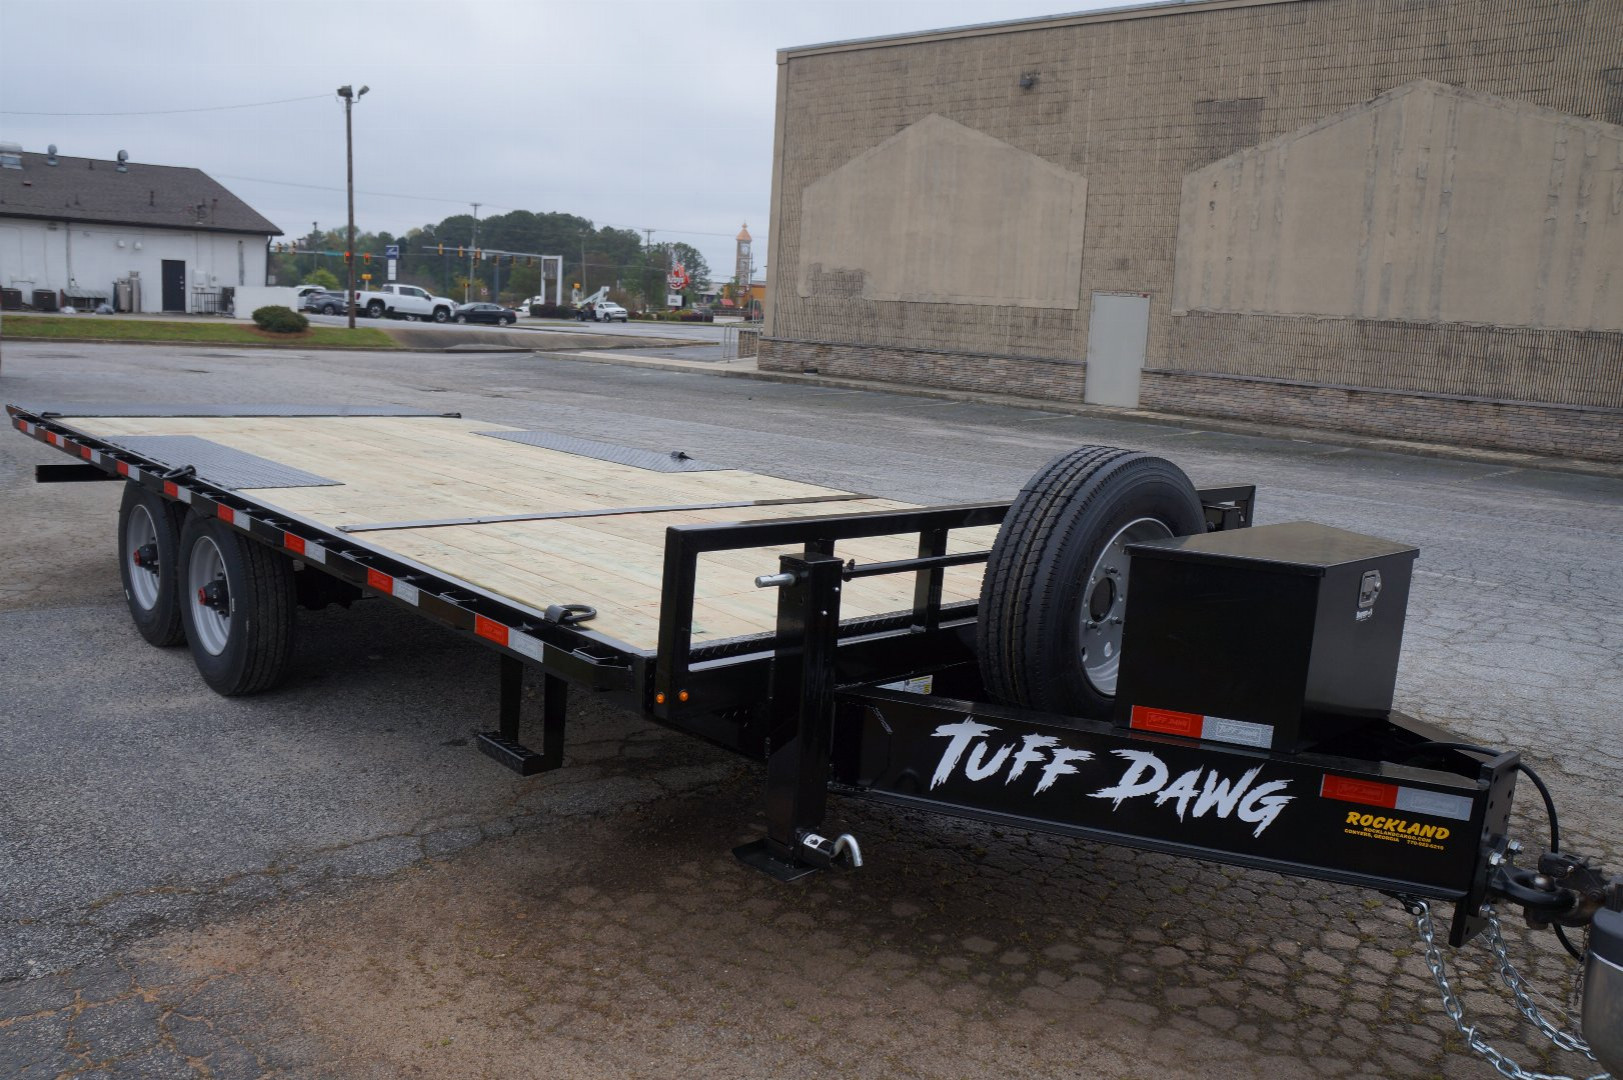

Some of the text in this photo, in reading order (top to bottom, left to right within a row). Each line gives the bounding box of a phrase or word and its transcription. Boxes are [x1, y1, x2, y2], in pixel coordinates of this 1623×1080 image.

[930, 716, 1297, 839] TUFF DAWG
[1345, 812, 1450, 840] ROCKLAND
[1364, 827, 1431, 843] ROCKLANDCARGO.COM
[1373, 833, 1400, 842] GEORGIA
